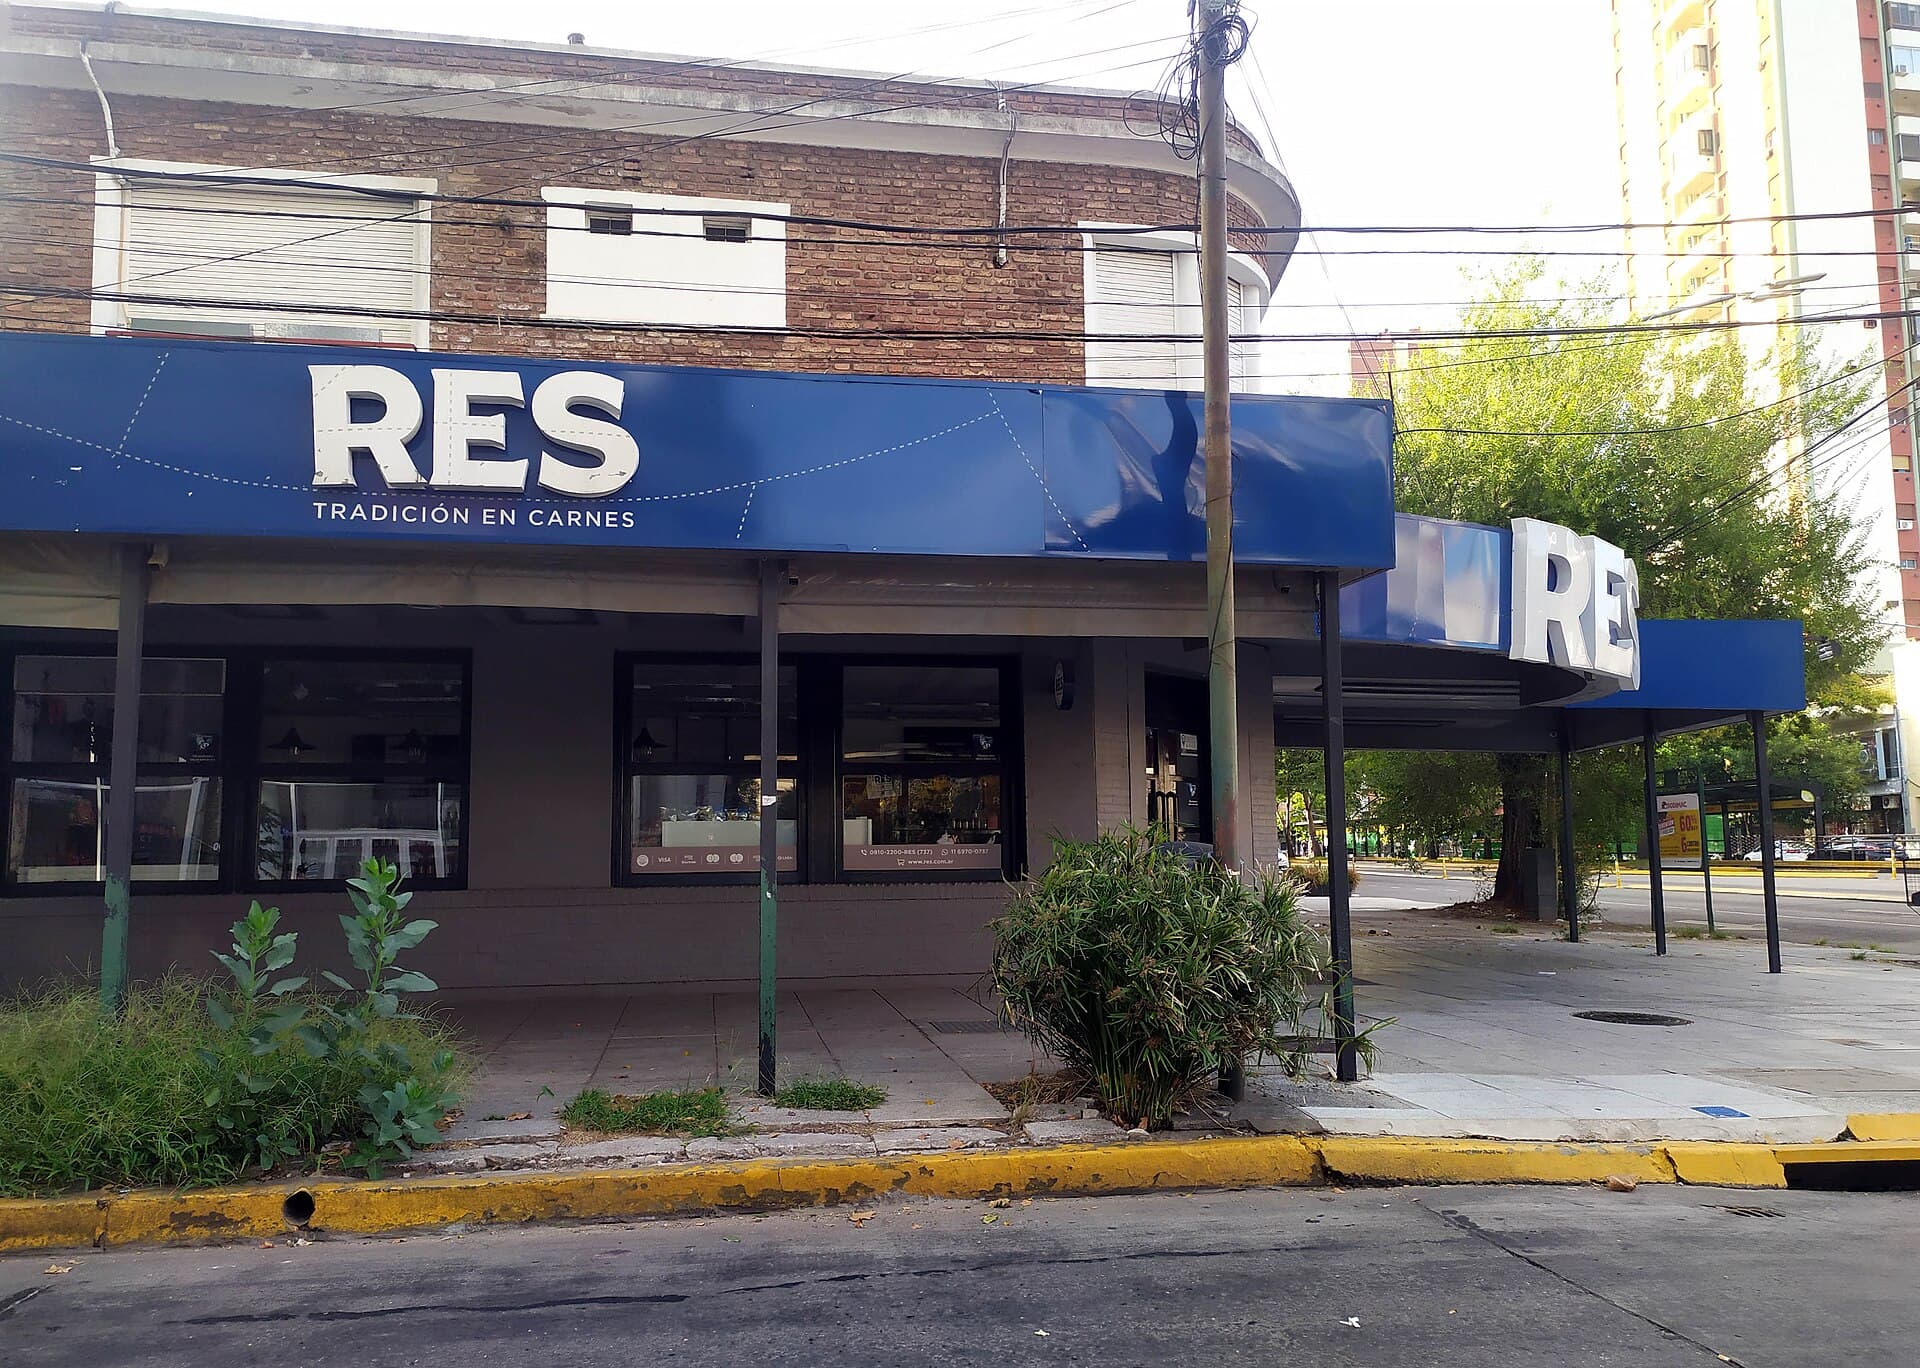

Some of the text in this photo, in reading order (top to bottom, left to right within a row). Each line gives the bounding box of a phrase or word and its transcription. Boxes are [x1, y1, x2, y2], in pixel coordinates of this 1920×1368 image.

[308, 364, 640, 498] RES
[312, 502, 636, 529] TRADICIÓN EN CARNES
